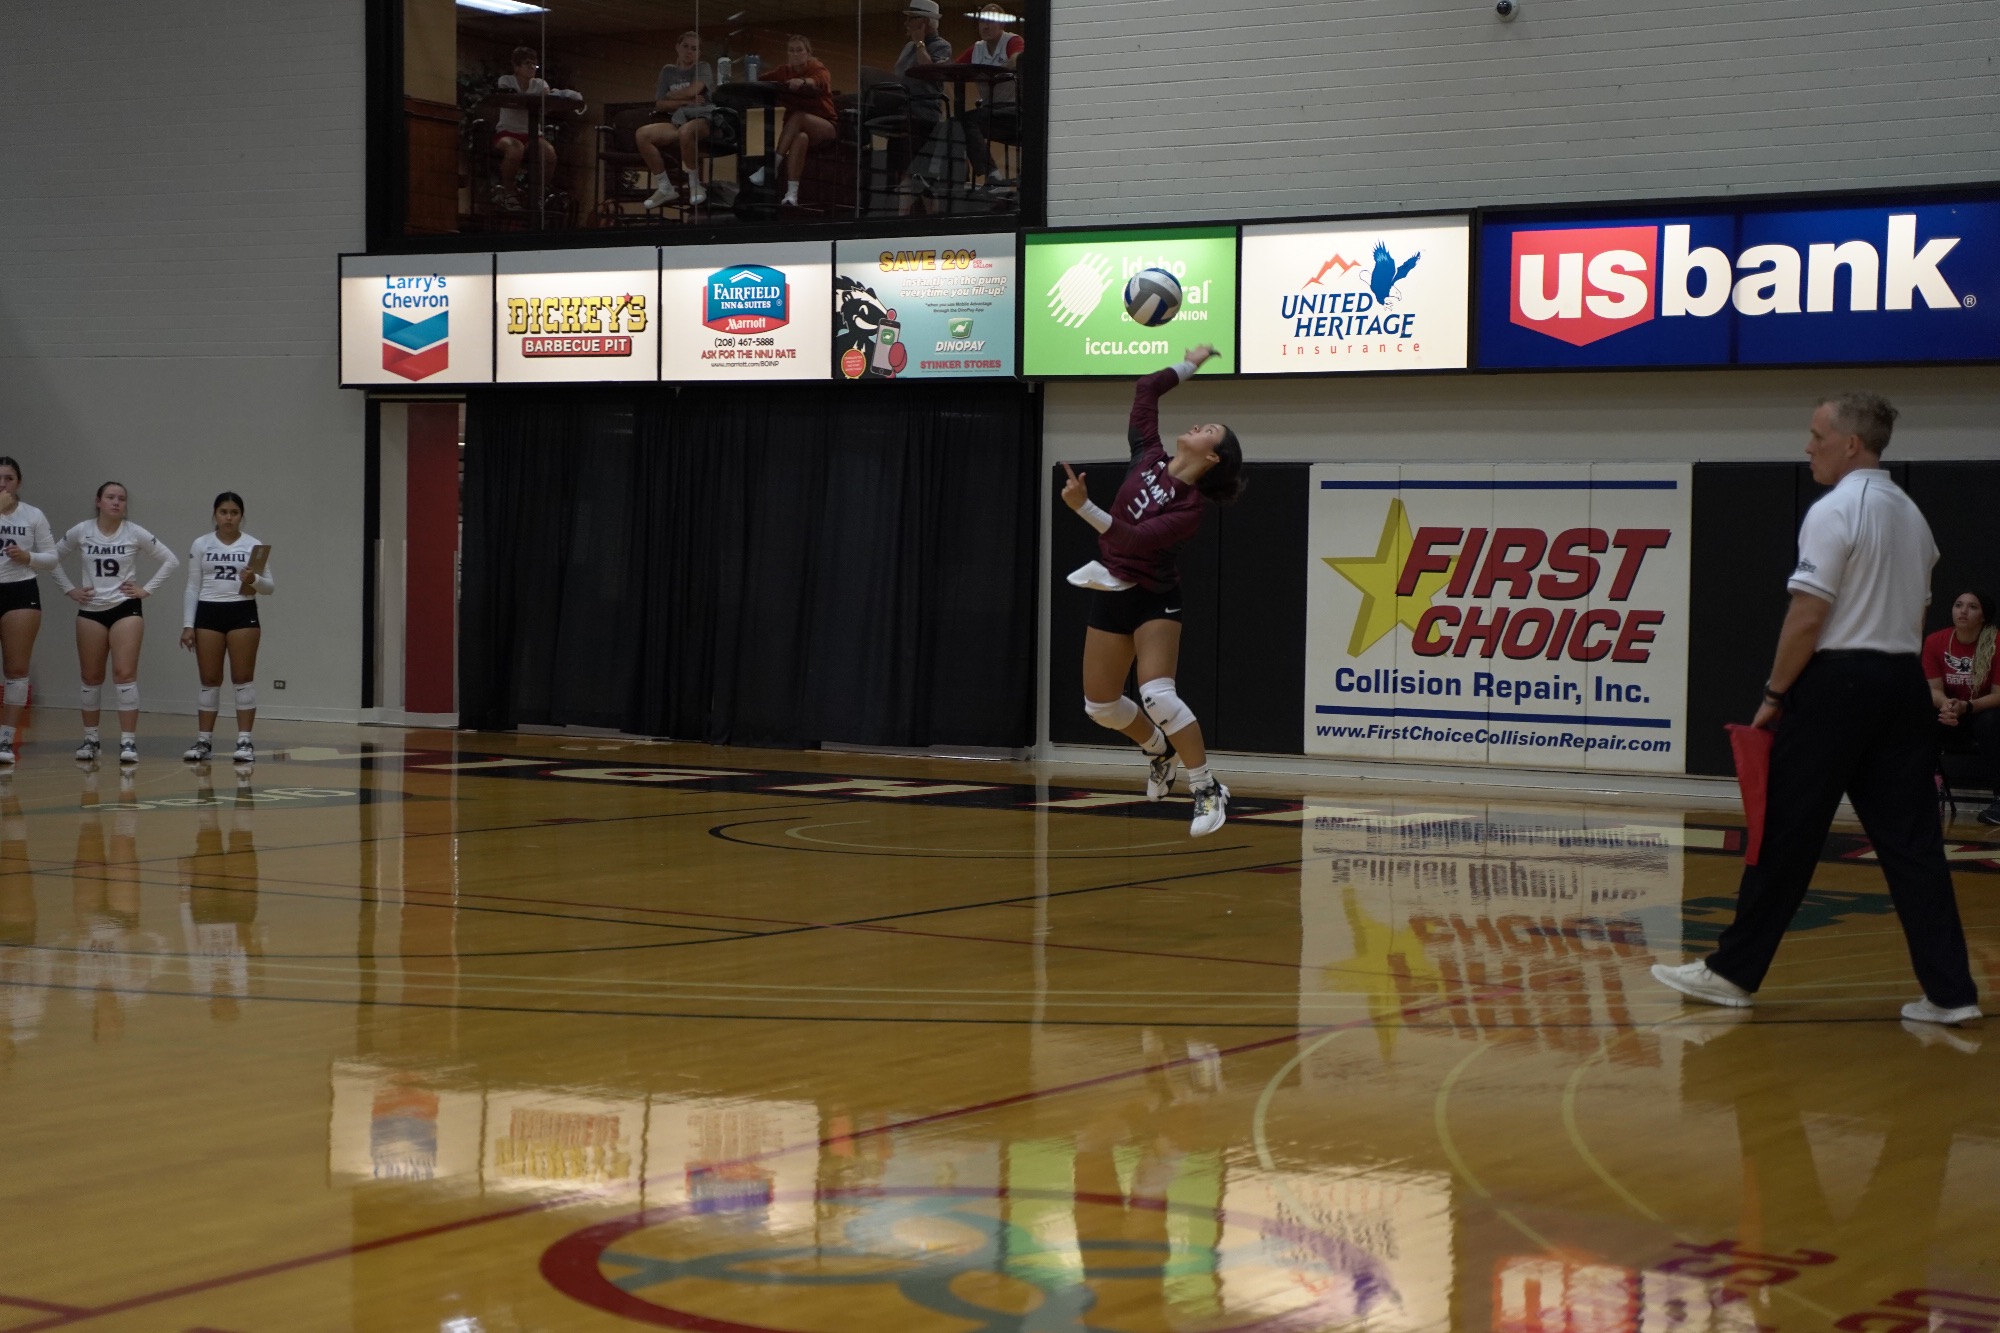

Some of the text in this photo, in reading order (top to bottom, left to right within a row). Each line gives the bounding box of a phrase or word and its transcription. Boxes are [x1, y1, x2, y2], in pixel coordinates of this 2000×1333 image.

[879, 250, 937, 272] SAVE
[385, 273, 447, 292] Larry's
[902, 276, 1007, 288] Instantly at the pump
[382, 292, 449, 309] Chevron
[899, 287, 948, 299] everytime
[950, 288, 970, 298] you
[721, 301, 737, 310] INN
[744, 300, 771, 309] SUITES
[1281, 292, 1373, 319] UNITED
[725, 318, 766, 331] Marriott
[1294, 313, 1415, 340] HERITAGE
[525, 338, 627, 353] BARBECUE PIT
[714, 337, 774, 348] (208) 467-5888
[935, 340, 986, 353] DINOPAY
[1085, 337, 1168, 355] iccu.com
[1282, 342, 1420, 356] Insurance
[701, 349, 796, 359] ASK FOR THE NNU RATE
[920, 359, 1002, 370] STINKER STORES
[87, 545, 126, 555] TAMIU
[206, 552, 246, 562] TAMIU
[93, 558, 120, 577] 19
[1394, 526, 1672, 602] FIRST
[214, 565, 237, 581] 22
[1411, 605, 1665, 663] CHOICE
[1335, 667, 1650, 705] Collision Repair, Inc.
[1315, 724, 1672, 753] www.FirstChoiceCollisionRepair.com
